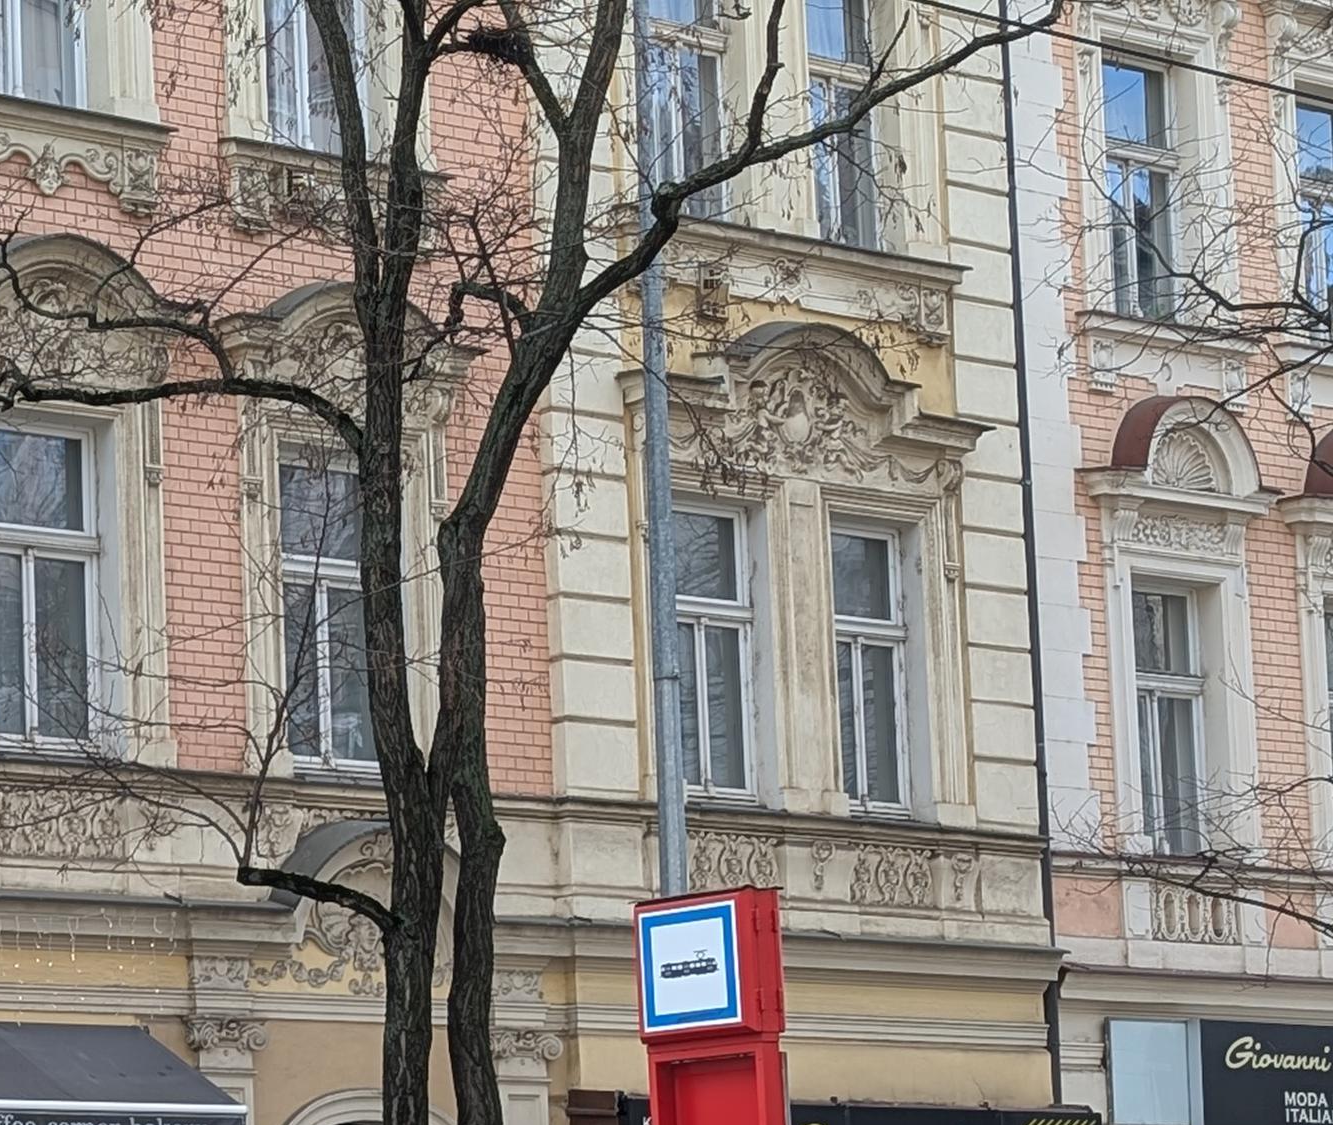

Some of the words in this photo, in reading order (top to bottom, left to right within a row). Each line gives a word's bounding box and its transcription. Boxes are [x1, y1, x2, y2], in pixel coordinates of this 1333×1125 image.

[1225, 1036, 1332, 1072] Giovanni
[1284, 1091, 1329, 1107] MODA
[1285, 1108, 1333, 1124] ITALIA
